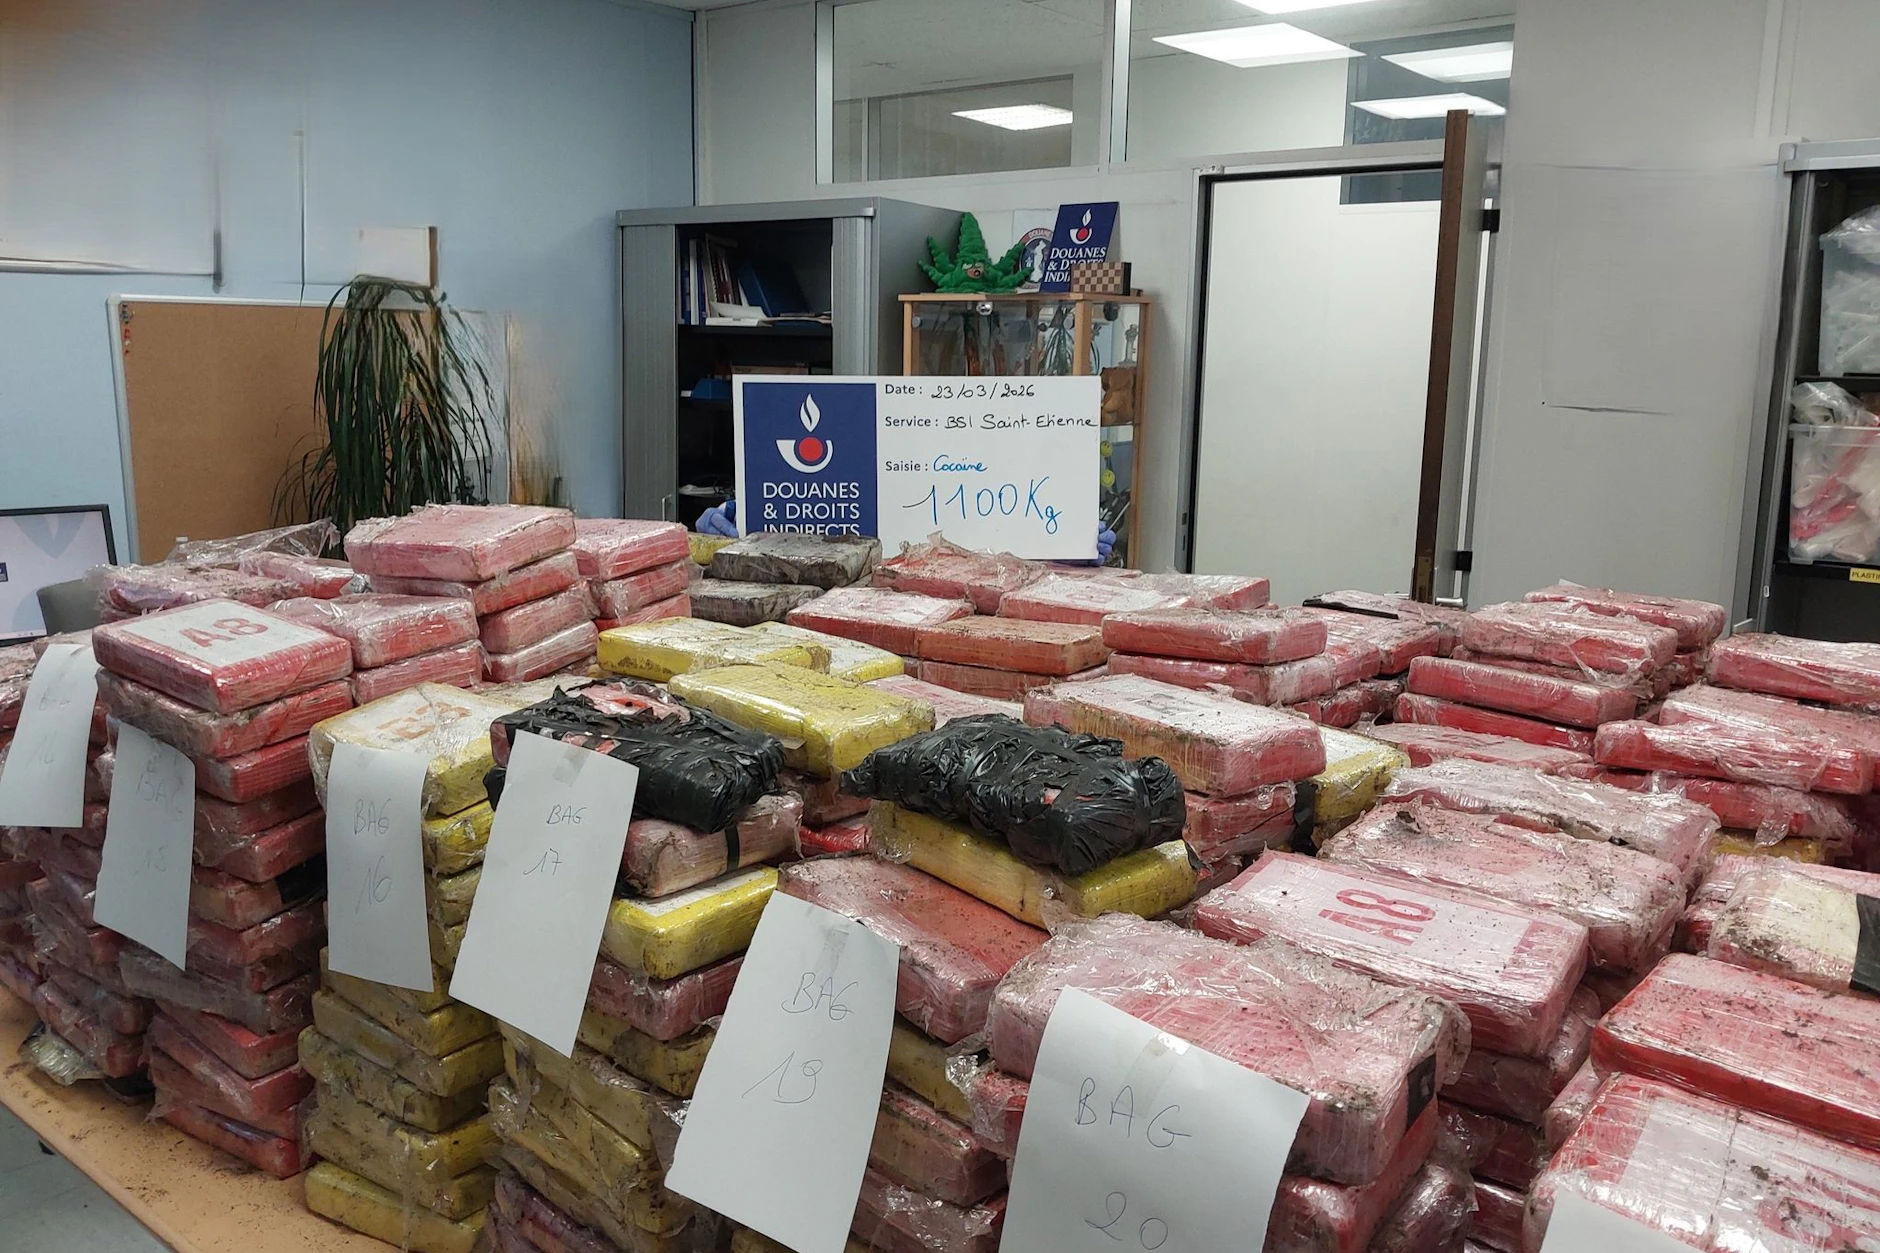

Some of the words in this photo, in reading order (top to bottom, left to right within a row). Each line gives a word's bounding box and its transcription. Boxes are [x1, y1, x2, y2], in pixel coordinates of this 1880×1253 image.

[1049, 246, 1107, 260] DOUANES
[931, 382, 1035, 399] 23/03/2026
[763, 482, 860, 499] DOUANES
[763, 503, 778, 519] &
[786, 502, 860, 519] DROITS
[178, 617, 269, 647] A8
[546, 804, 587, 826] BAG
[523, 848, 563, 876] 17
[355, 855, 393, 914] 16
[1318, 888, 1436, 946] A8
[781, 972, 859, 1020] BAG
[1076, 1077, 1193, 1149] BAG
[1083, 1190, 1170, 1251] 20
